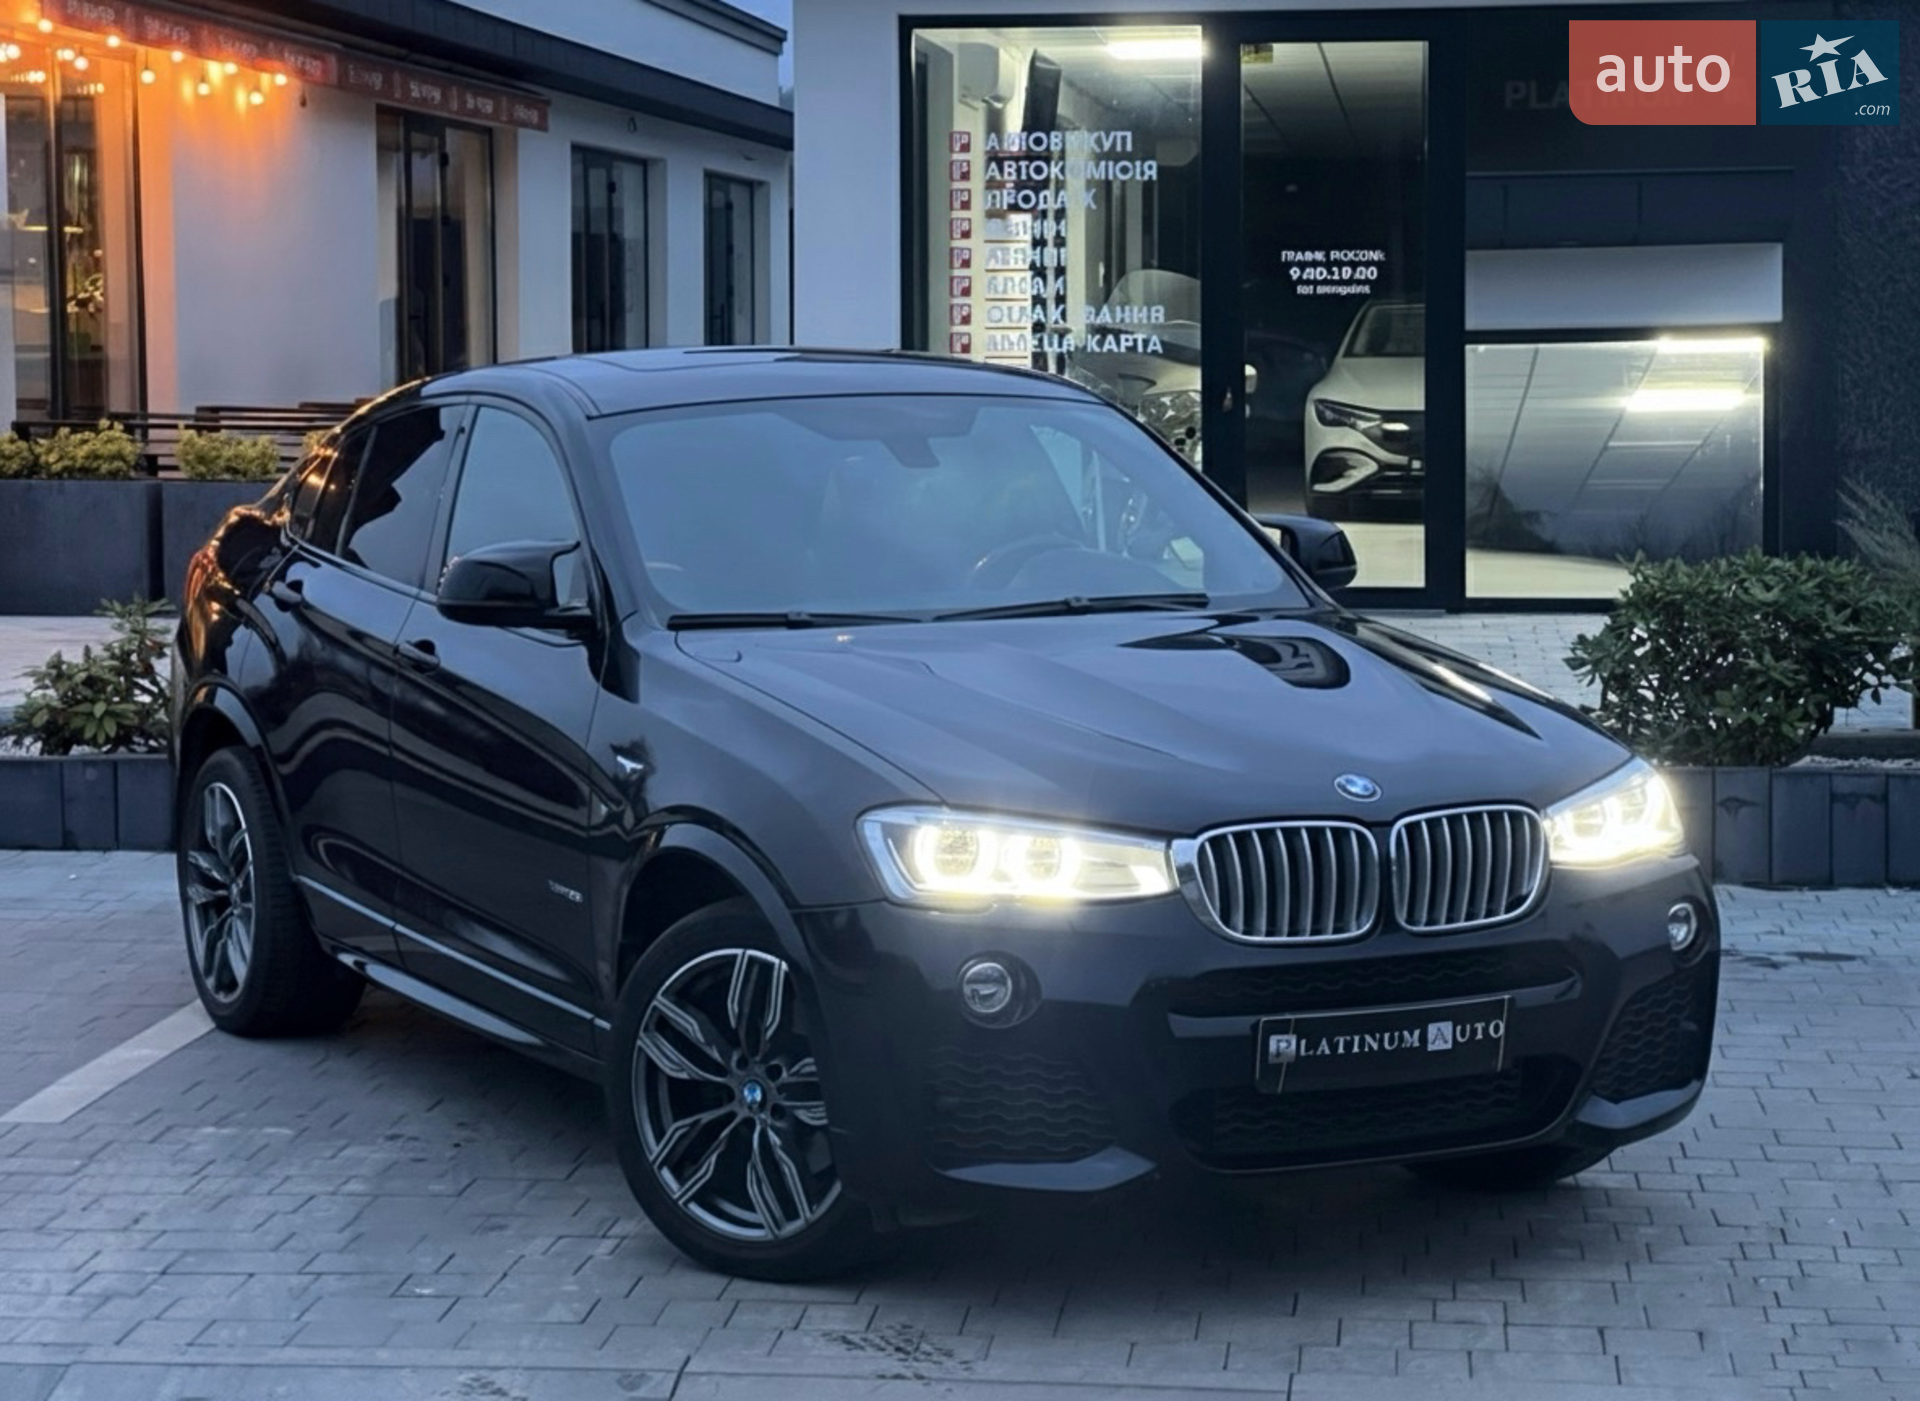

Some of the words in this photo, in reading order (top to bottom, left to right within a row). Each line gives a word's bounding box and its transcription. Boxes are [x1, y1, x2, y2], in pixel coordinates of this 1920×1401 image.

[1087, 334, 1163, 353] КАРТА
[1269, 1029, 1421, 1063] PLATINUM
[1427, 1019, 1504, 1051] AUTO
